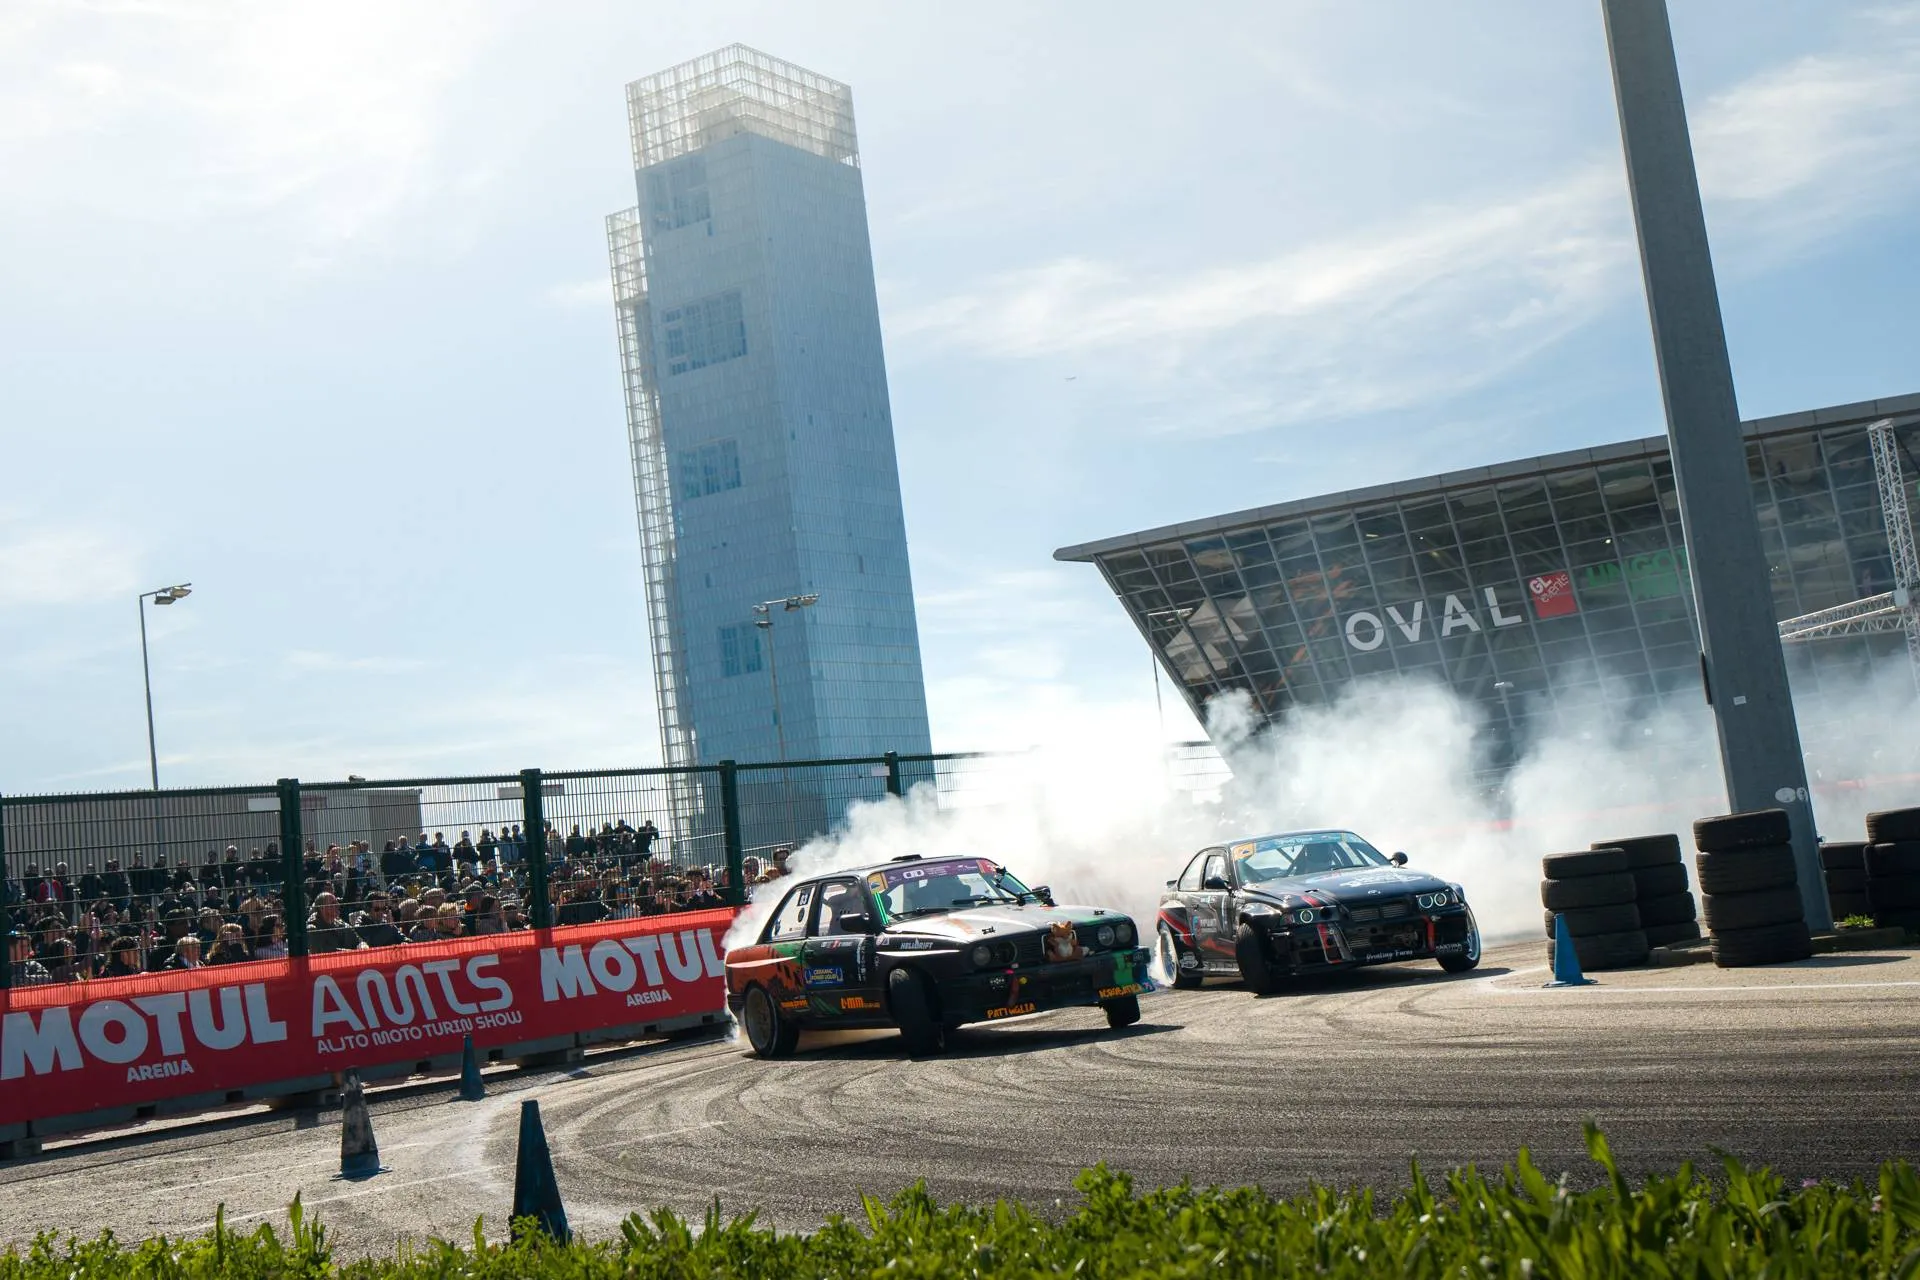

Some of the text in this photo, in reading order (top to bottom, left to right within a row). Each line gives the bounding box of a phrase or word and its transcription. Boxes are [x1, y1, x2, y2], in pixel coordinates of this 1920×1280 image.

[1529, 577, 1553, 595] GL
[1539, 574, 1570, 603] events
[1345, 587, 1522, 651] OVAL
[540, 928, 726, 1002] MOTUL
[312, 954, 513, 1038] AMTS
[625, 989, 673, 1008] ARENA
[0, 982, 287, 1081] MOTUL
[317, 1010, 523, 1054] AUTO MOTO TURIN SHOW
[127, 1059, 195, 1083] ARENA
